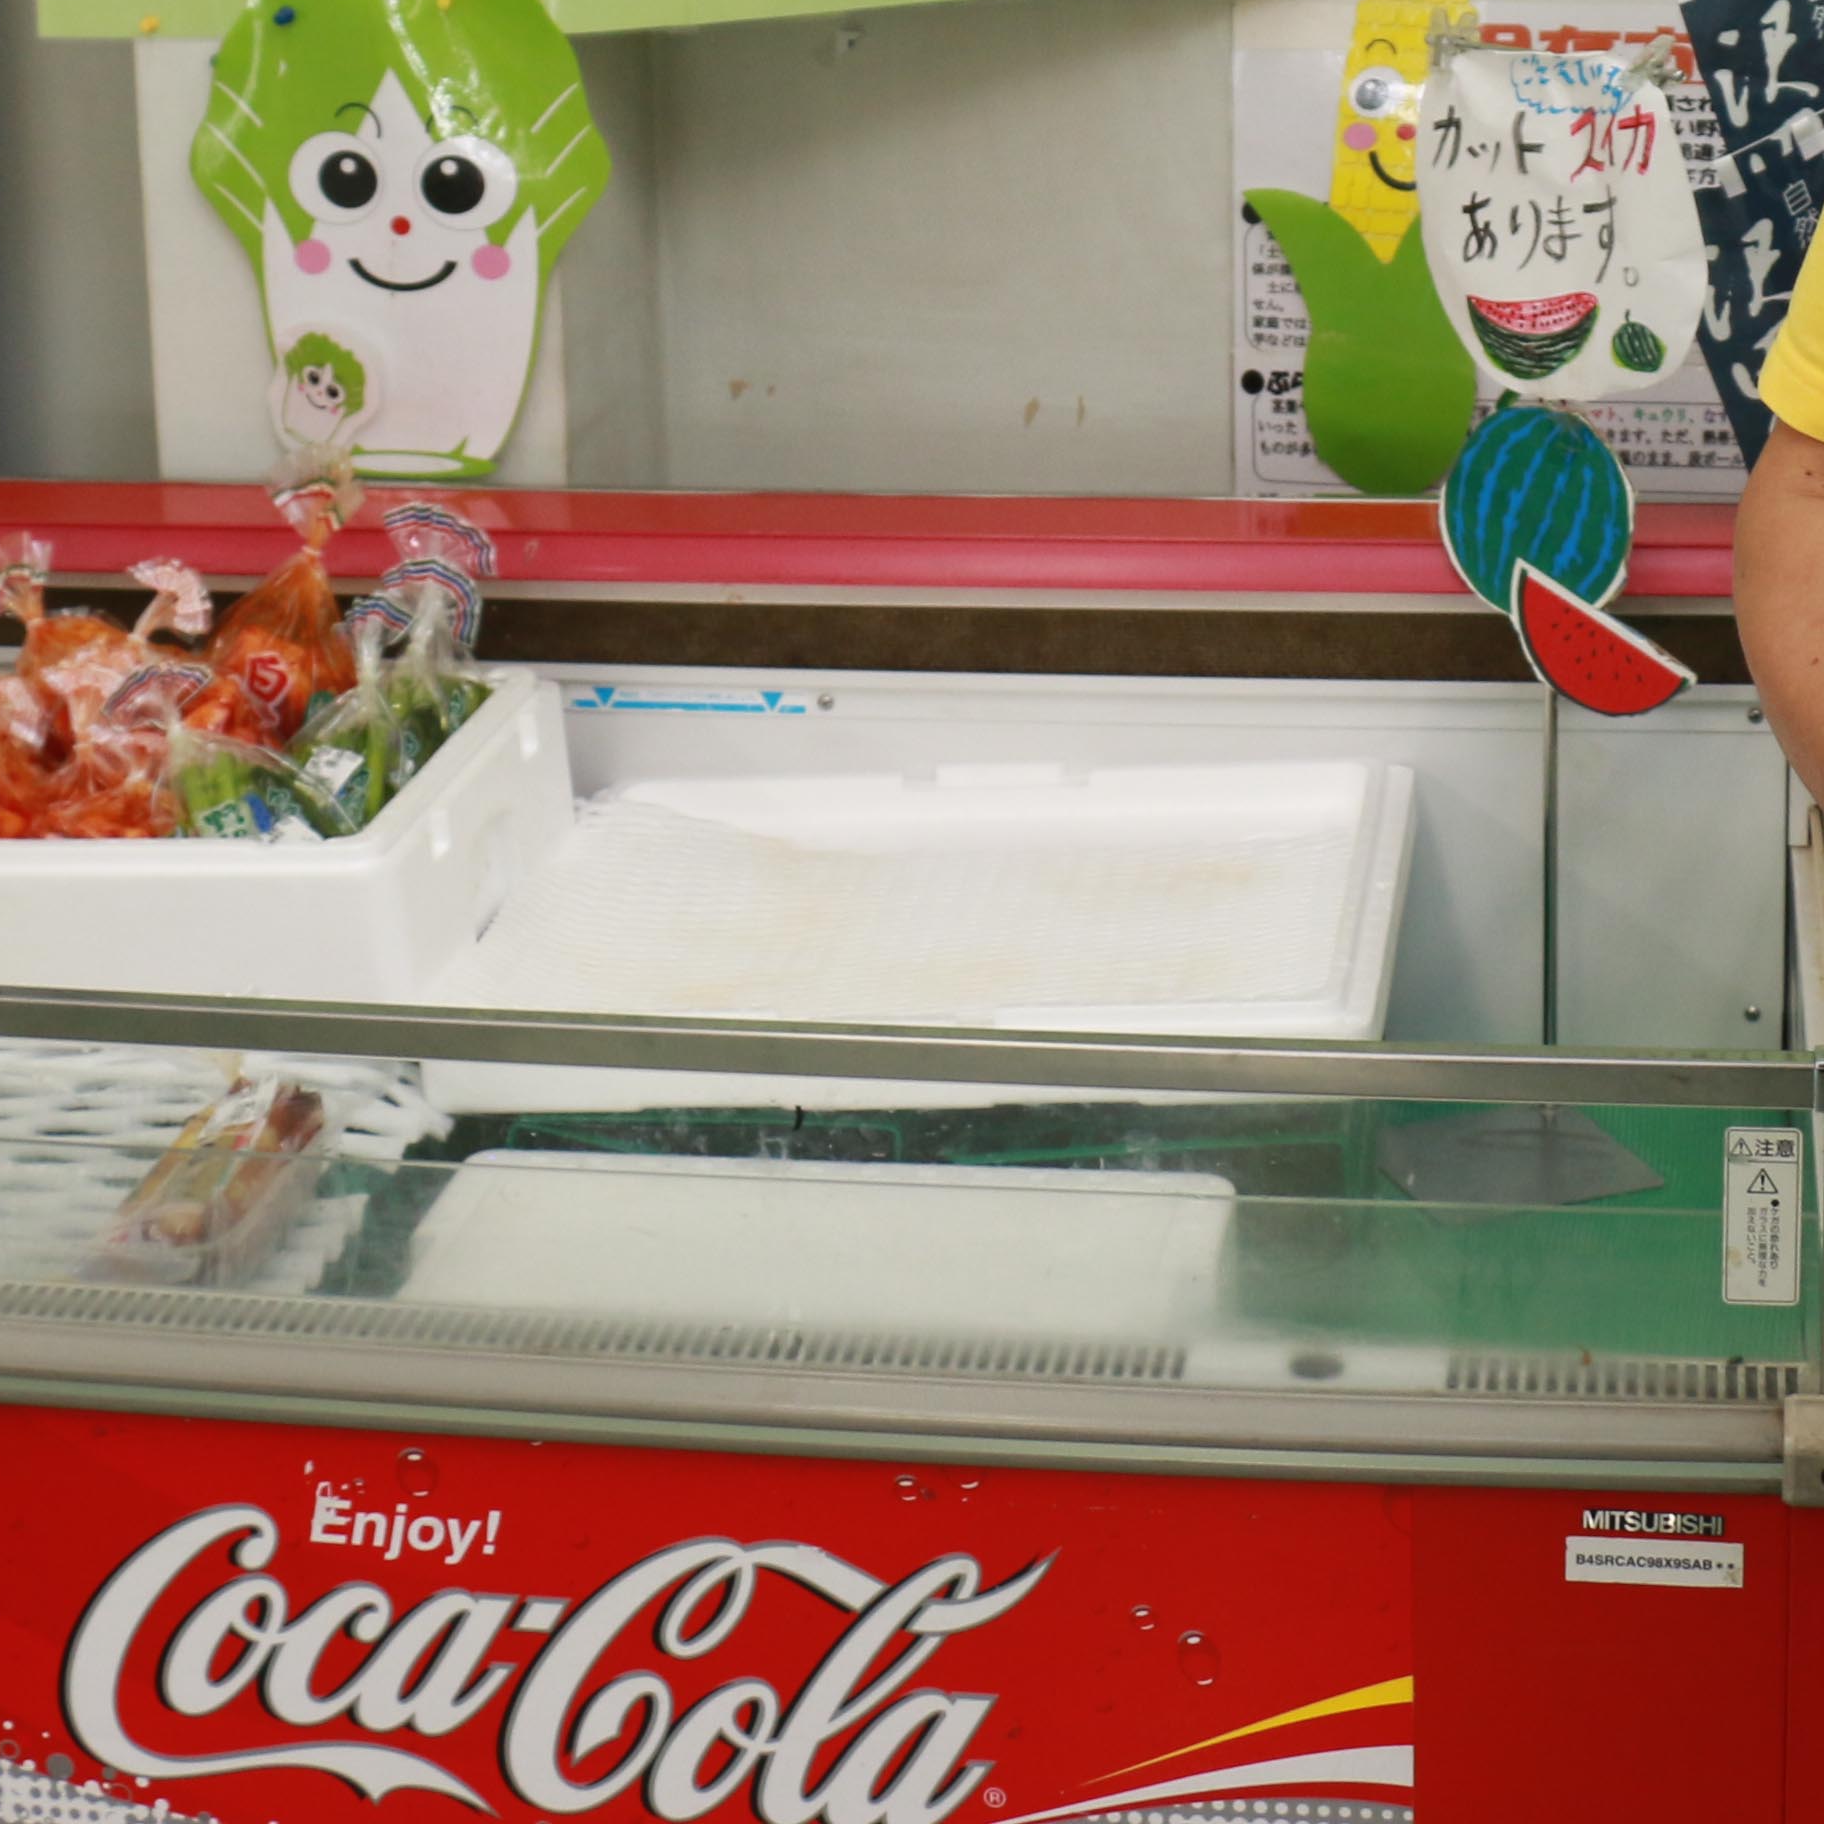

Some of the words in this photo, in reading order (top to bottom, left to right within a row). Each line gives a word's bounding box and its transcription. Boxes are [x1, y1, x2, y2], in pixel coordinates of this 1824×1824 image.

[1433, 110, 1544, 176] カット
[1570, 104, 1656, 182] スイカ
[1461, 194, 1641, 287] あります。
[1755, 1139, 1795, 1157] 注意
[311, 1488, 501, 1568] Enjoy!
[1582, 1510, 1725, 1535] MITSUBISHI
[63, 1500, 1062, 1824] Coca-Cola
